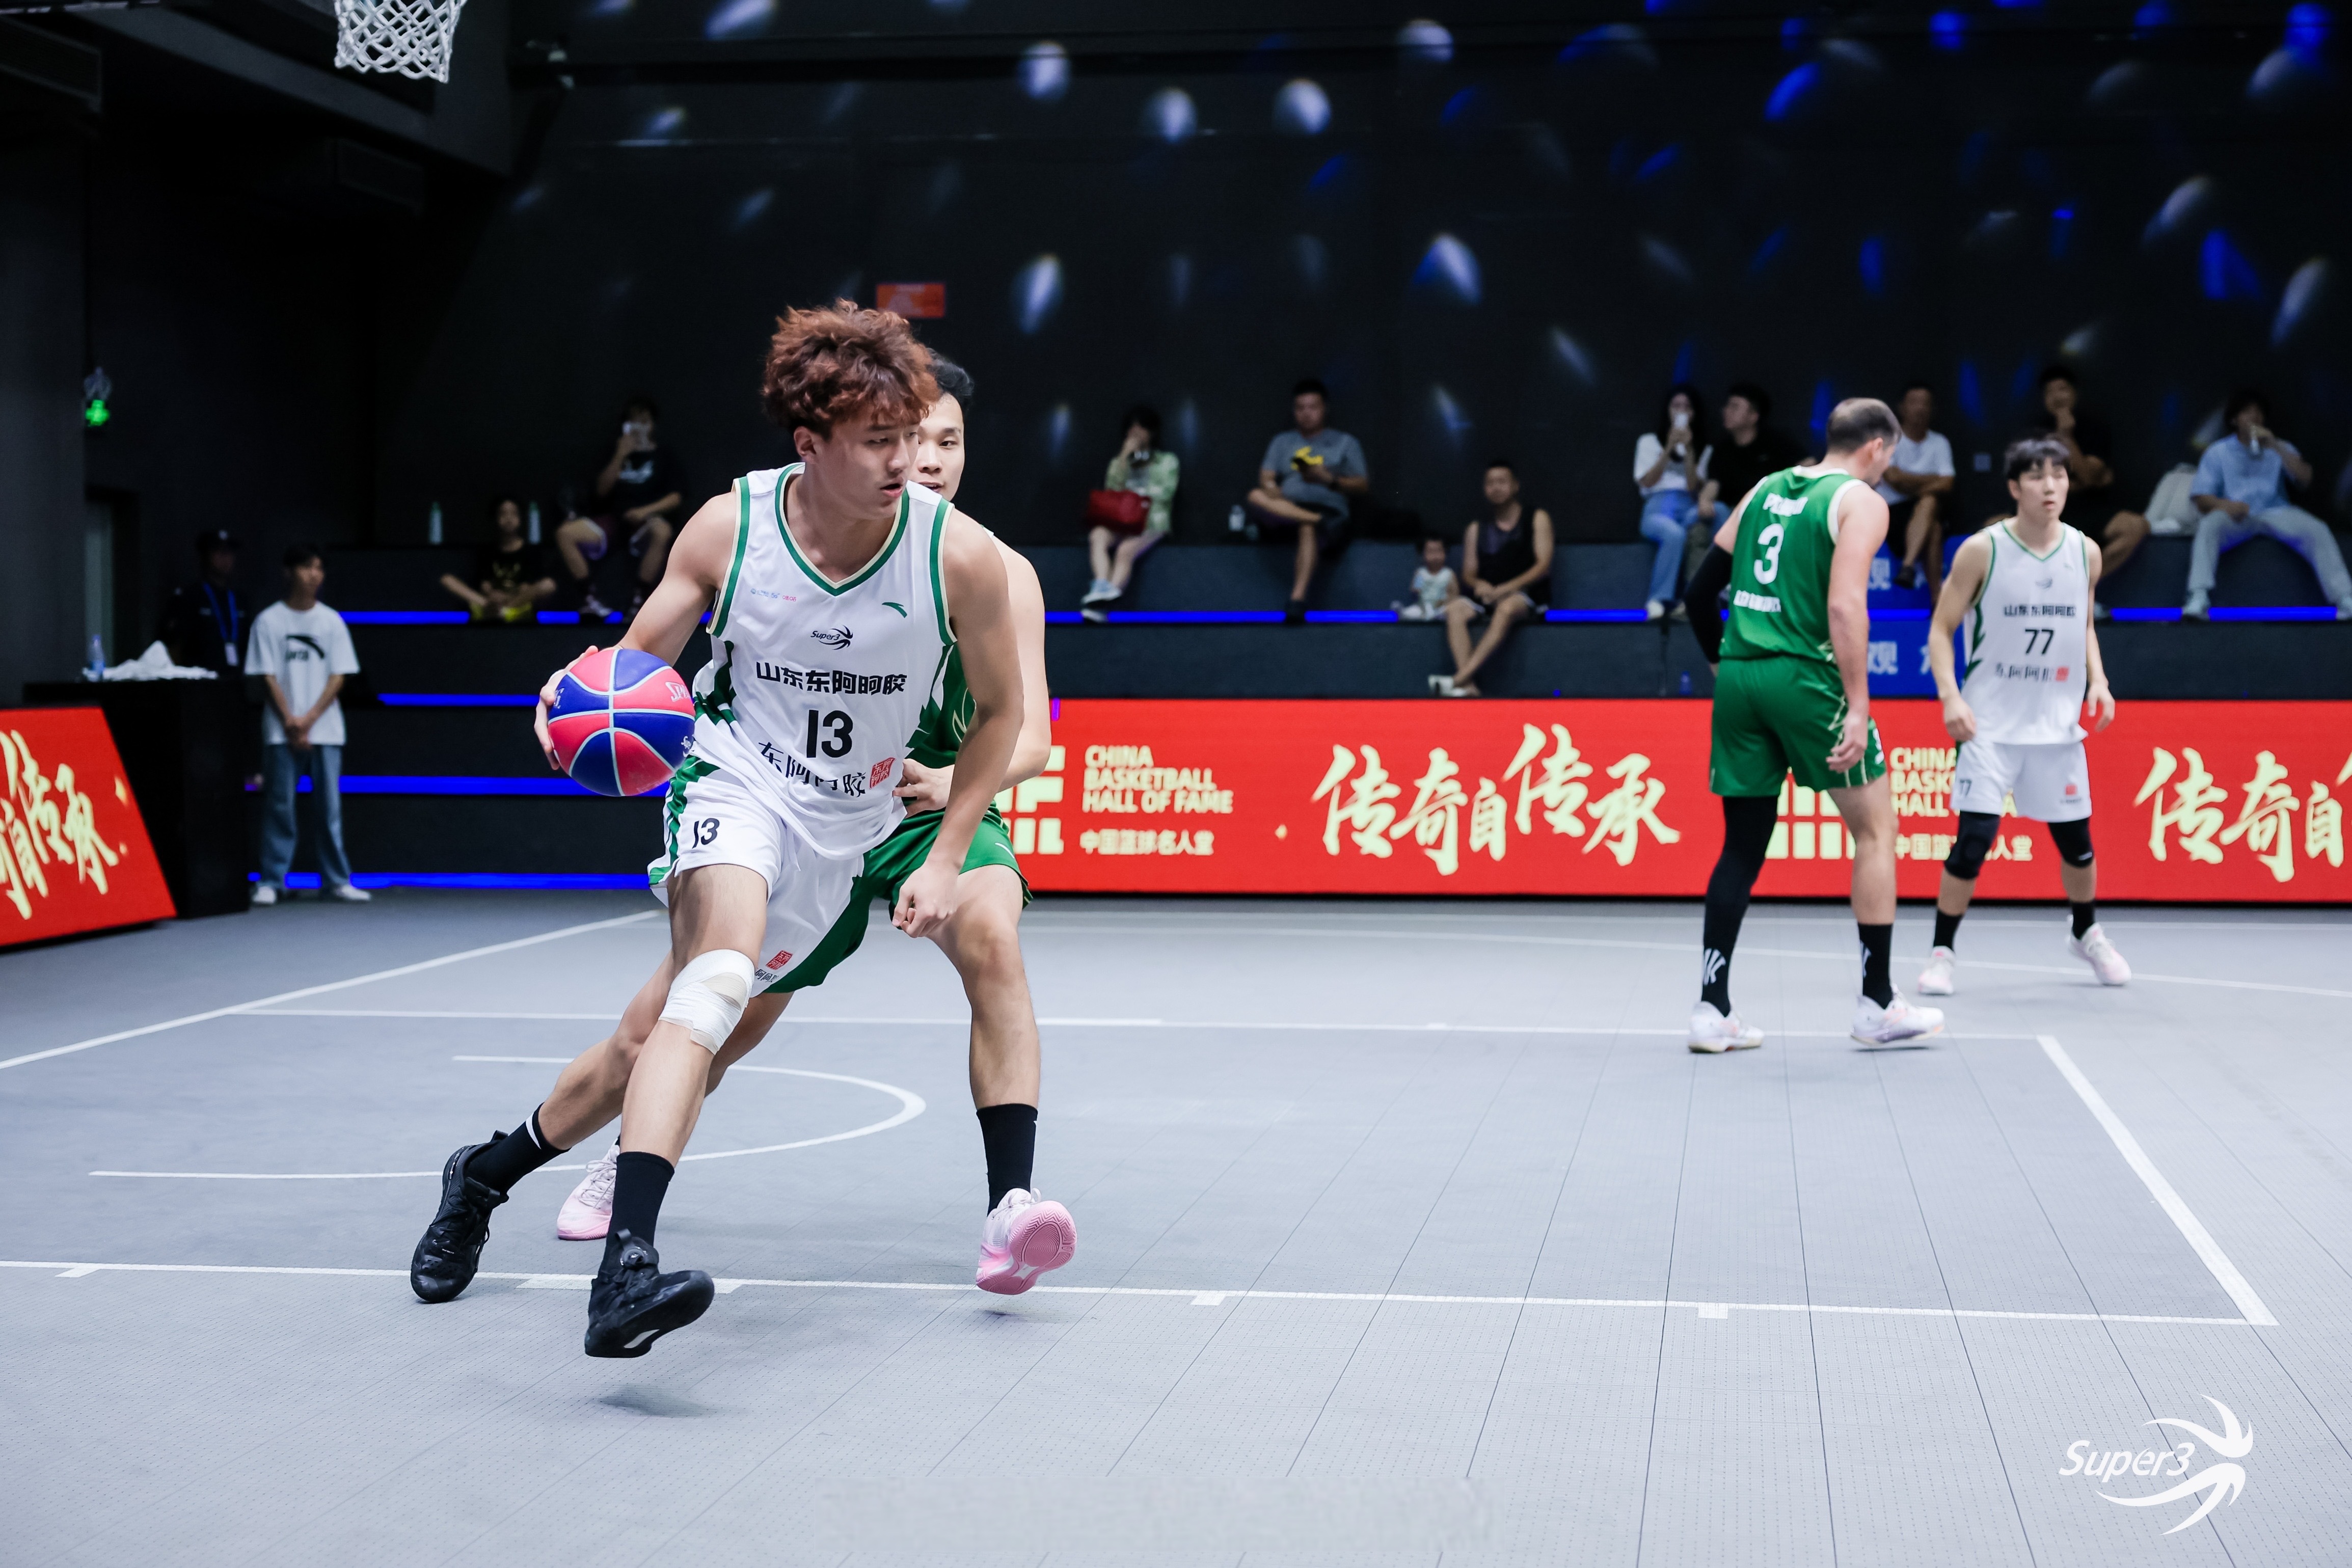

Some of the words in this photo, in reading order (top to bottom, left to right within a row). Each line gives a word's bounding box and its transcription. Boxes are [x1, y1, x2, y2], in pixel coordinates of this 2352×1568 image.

[1754, 523, 1784, 584] 3
[810, 630, 841, 641] Super3
[2025, 629, 2055, 655] 77
[756, 662, 907, 695] 山东东阿阿胶
[806, 709, 853, 759] 13
[1085, 745, 1155, 768] CHINA
[1889, 747, 1957, 771] CHINA
[1083, 767, 1218, 791] BASKETBALL
[1960, 779, 1972, 796] 77
[1082, 790, 1139, 813] HALL
[1140, 791, 1171, 813] OF
[1173, 790, 1234, 814] FAME
[1311, 723, 1681, 876] 传奇自传承
[1890, 793, 1950, 818] HALL
[2133, 746, 2352, 883] 传奇自
[692, 818, 720, 849] 13
